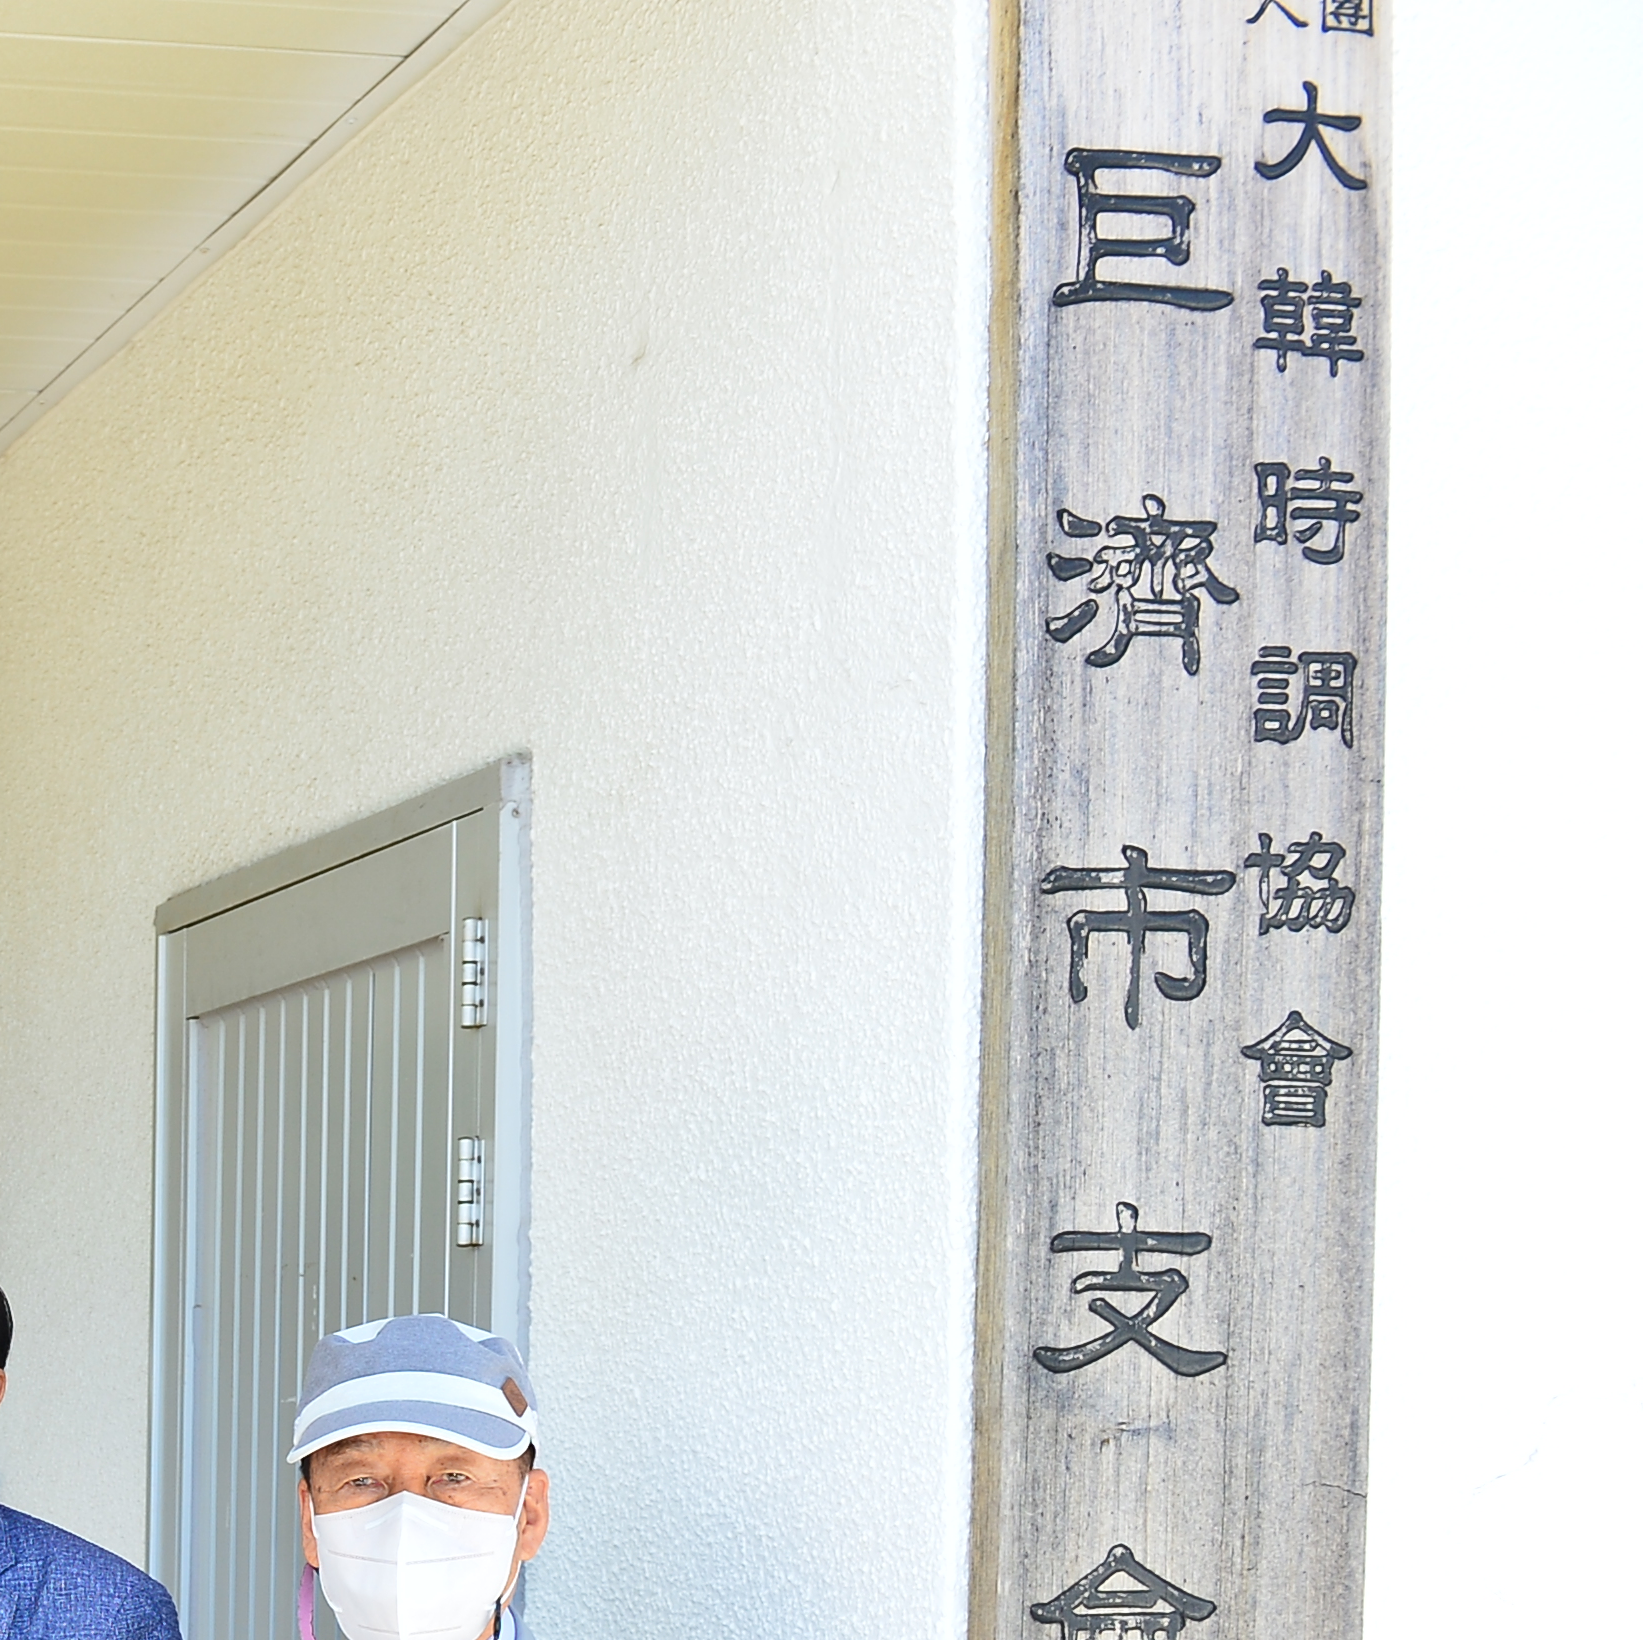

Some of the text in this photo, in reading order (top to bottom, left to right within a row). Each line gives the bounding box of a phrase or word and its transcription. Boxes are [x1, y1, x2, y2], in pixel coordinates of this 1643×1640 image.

[1242, 80, 1368, 1128] 大韓時調協會
